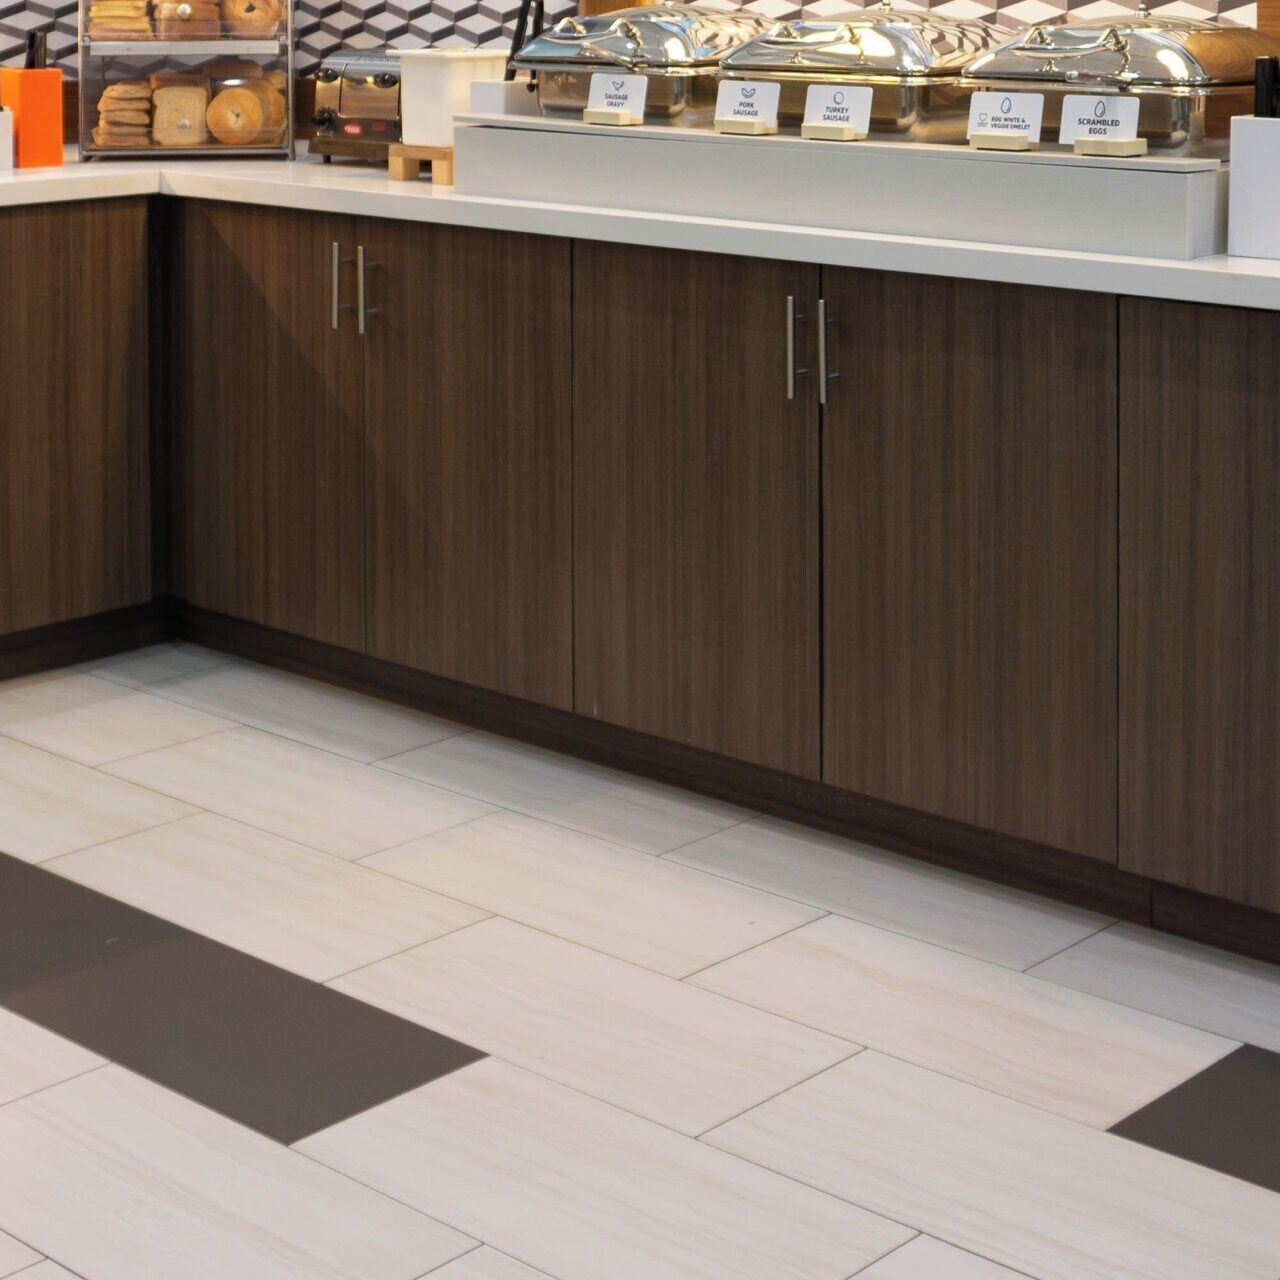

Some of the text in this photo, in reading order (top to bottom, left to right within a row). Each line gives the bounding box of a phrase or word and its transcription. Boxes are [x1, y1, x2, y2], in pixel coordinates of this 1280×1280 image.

[605, 93, 628, 101] SAUSAGE
[738, 101, 754, 109] PORK
[733, 108, 758, 117] SAUSAGE
[825, 106, 849, 114] TURKEY
[822, 113, 850, 122] SAUSAGE
[1078, 118, 1120, 127] SCRAMBLED
[1089, 127, 1107, 135] EGGS
